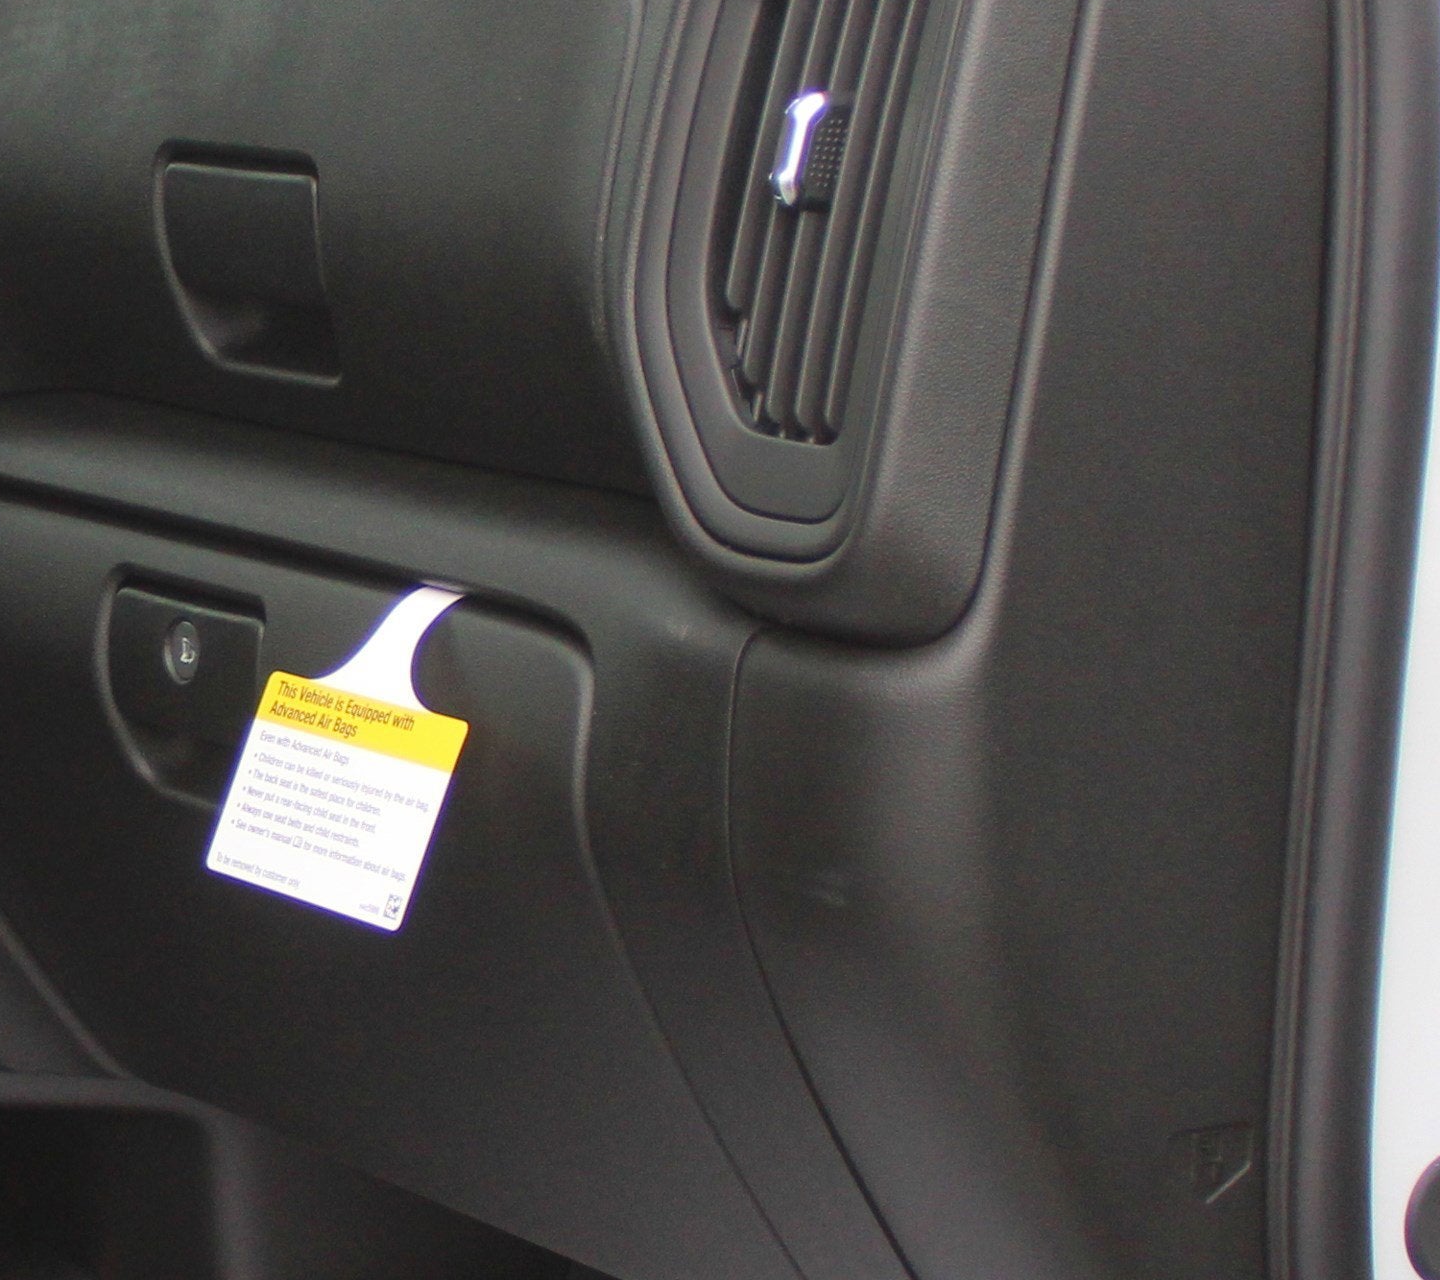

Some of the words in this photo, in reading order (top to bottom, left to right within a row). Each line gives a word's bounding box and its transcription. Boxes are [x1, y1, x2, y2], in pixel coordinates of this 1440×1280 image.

[270, 700, 317, 725] Advanced
[317, 713, 333, 730] Air
[332, 717, 359, 740] Bags
[277, 680, 299, 699] This
[299, 686, 335, 709] Vehicle
[335, 696, 345, 711] is
[344, 699, 392, 728] Equipped
[392, 712, 416, 731] with
